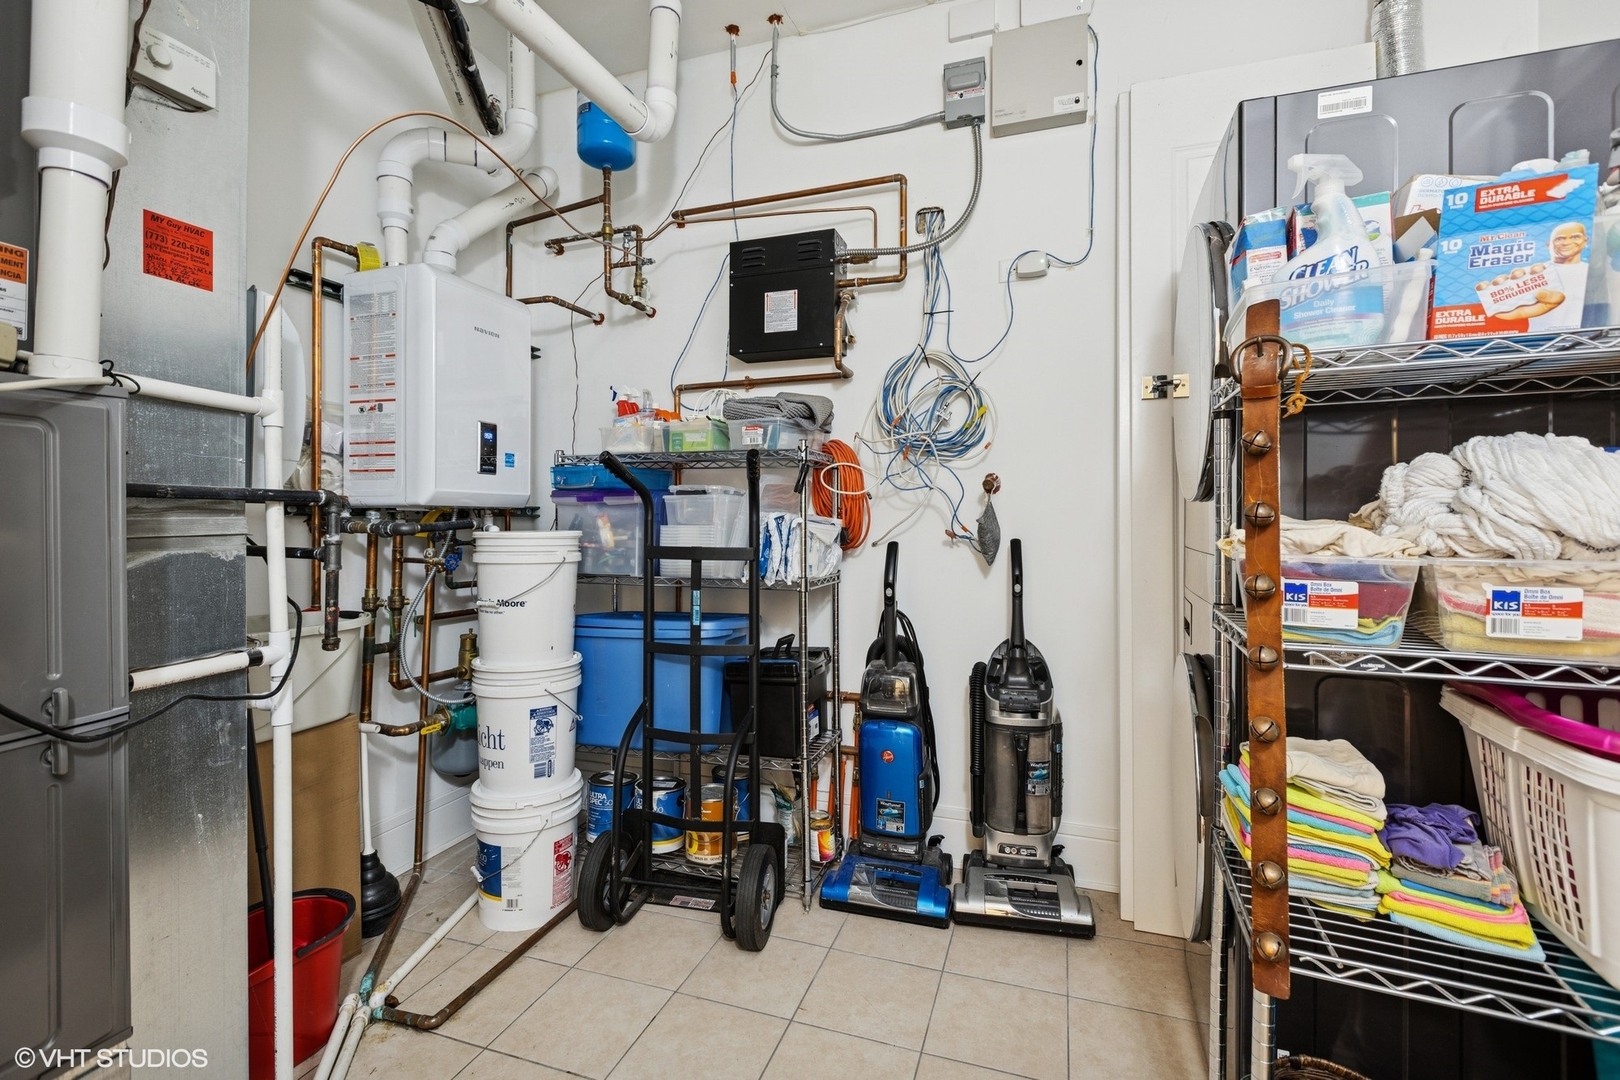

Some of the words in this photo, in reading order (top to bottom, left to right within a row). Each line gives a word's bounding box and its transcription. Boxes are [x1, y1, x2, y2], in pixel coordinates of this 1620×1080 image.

[1480, 184, 1520, 198] EXTRA
[1480, 188, 1536, 205] DURABLE
[1446, 192, 1468, 206] 10
[150, 214, 164, 224] MY
[166, 220, 182, 232] Guy
[184, 226, 206, 238] HVAC
[1498, 232, 1525, 240] Clean
[146, 230, 168, 245] (773)
[171, 238, 210, 257] 220-6766
[1440, 239, 1462, 252] 10
[1470, 240, 1534, 257] Magic
[160, 246, 189, 261] Emergency
[1469, 253, 1533, 268] Eraser
[1490, 286, 1514, 298] 80%
[1516, 274, 1546, 289] LESS
[1492, 280, 1548, 304] SCRUBBING
[1314, 299, 1335, 308] Daily
[1294, 308, 1323, 319] Shower
[1325, 305, 1356, 314] Cleaner
[1435, 314, 1486, 324] DURABLE
[1436, 309, 1472, 318] EXTRA
[497, 599, 526, 608] Moore
[1286, 593, 1306, 601] KIS
[1493, 601, 1518, 610] KIS
[590, 791, 607, 800] ULTRA
